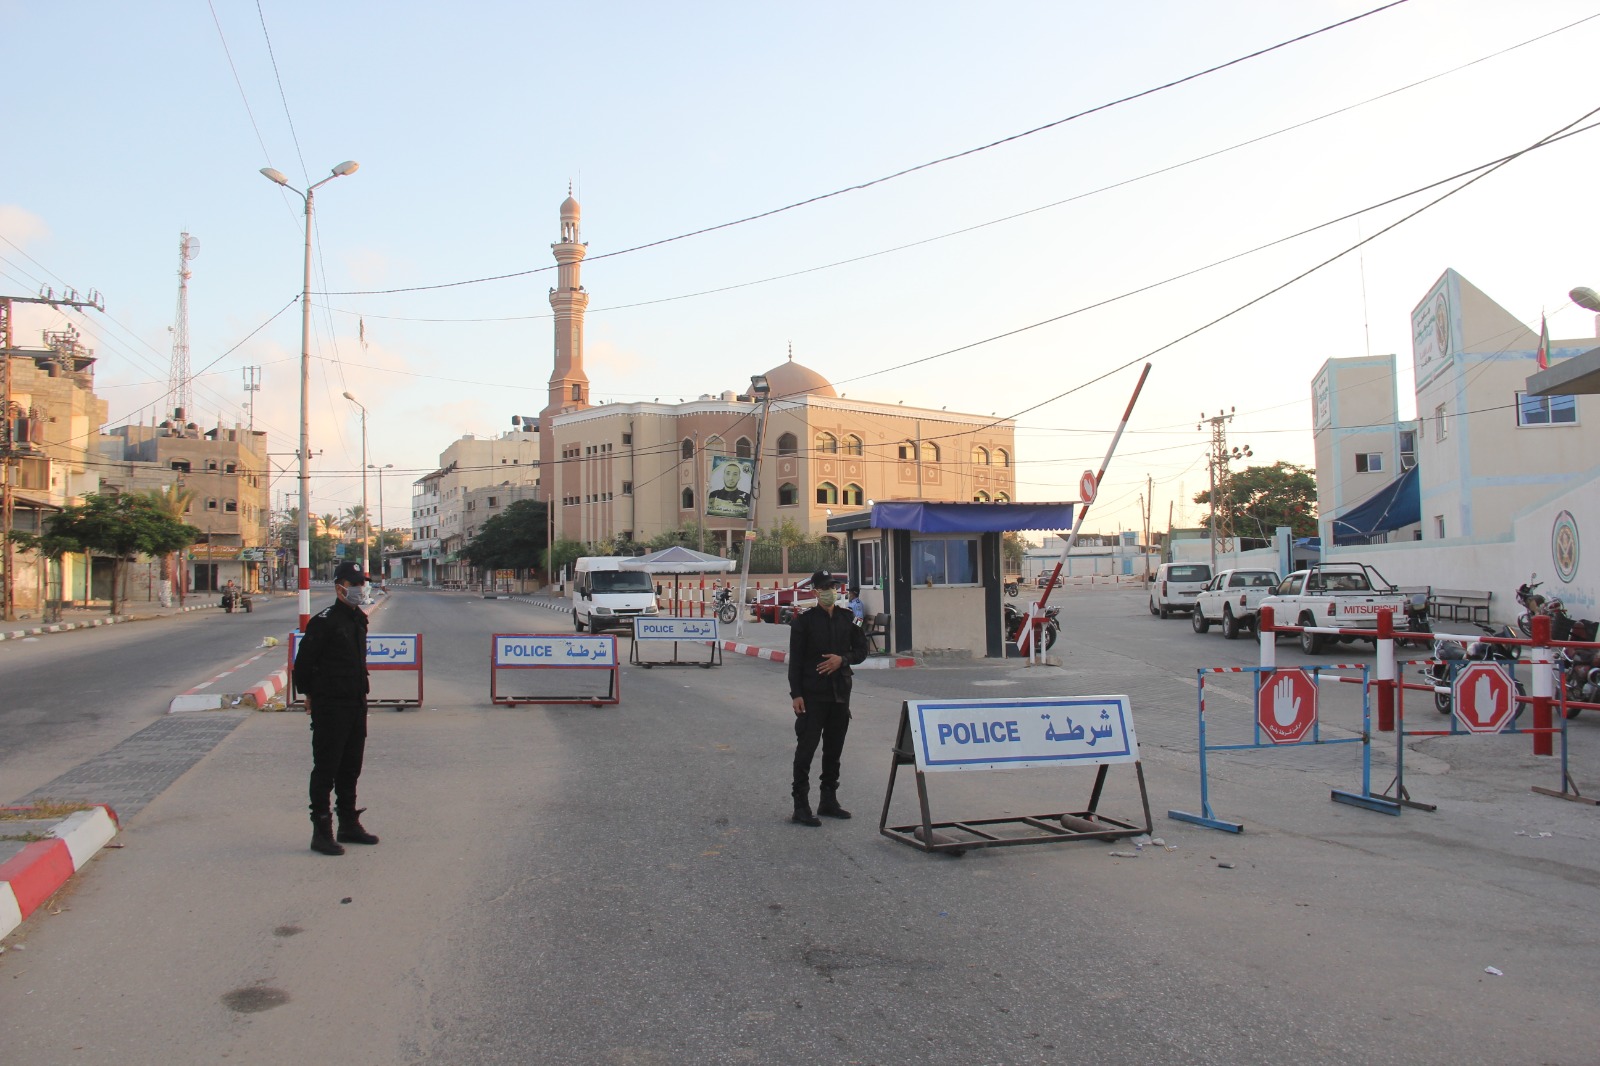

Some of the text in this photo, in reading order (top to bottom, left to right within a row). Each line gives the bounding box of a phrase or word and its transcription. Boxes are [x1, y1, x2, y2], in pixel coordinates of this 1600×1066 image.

[643, 625, 674, 633] POLICE
[682, 622, 711, 635] شرطة
[504, 645, 552, 657] POLICE
[565, 641, 607, 660] شرطة
[938, 720, 1020, 745] POLICE
[1041, 708, 1113, 746] شرطة
